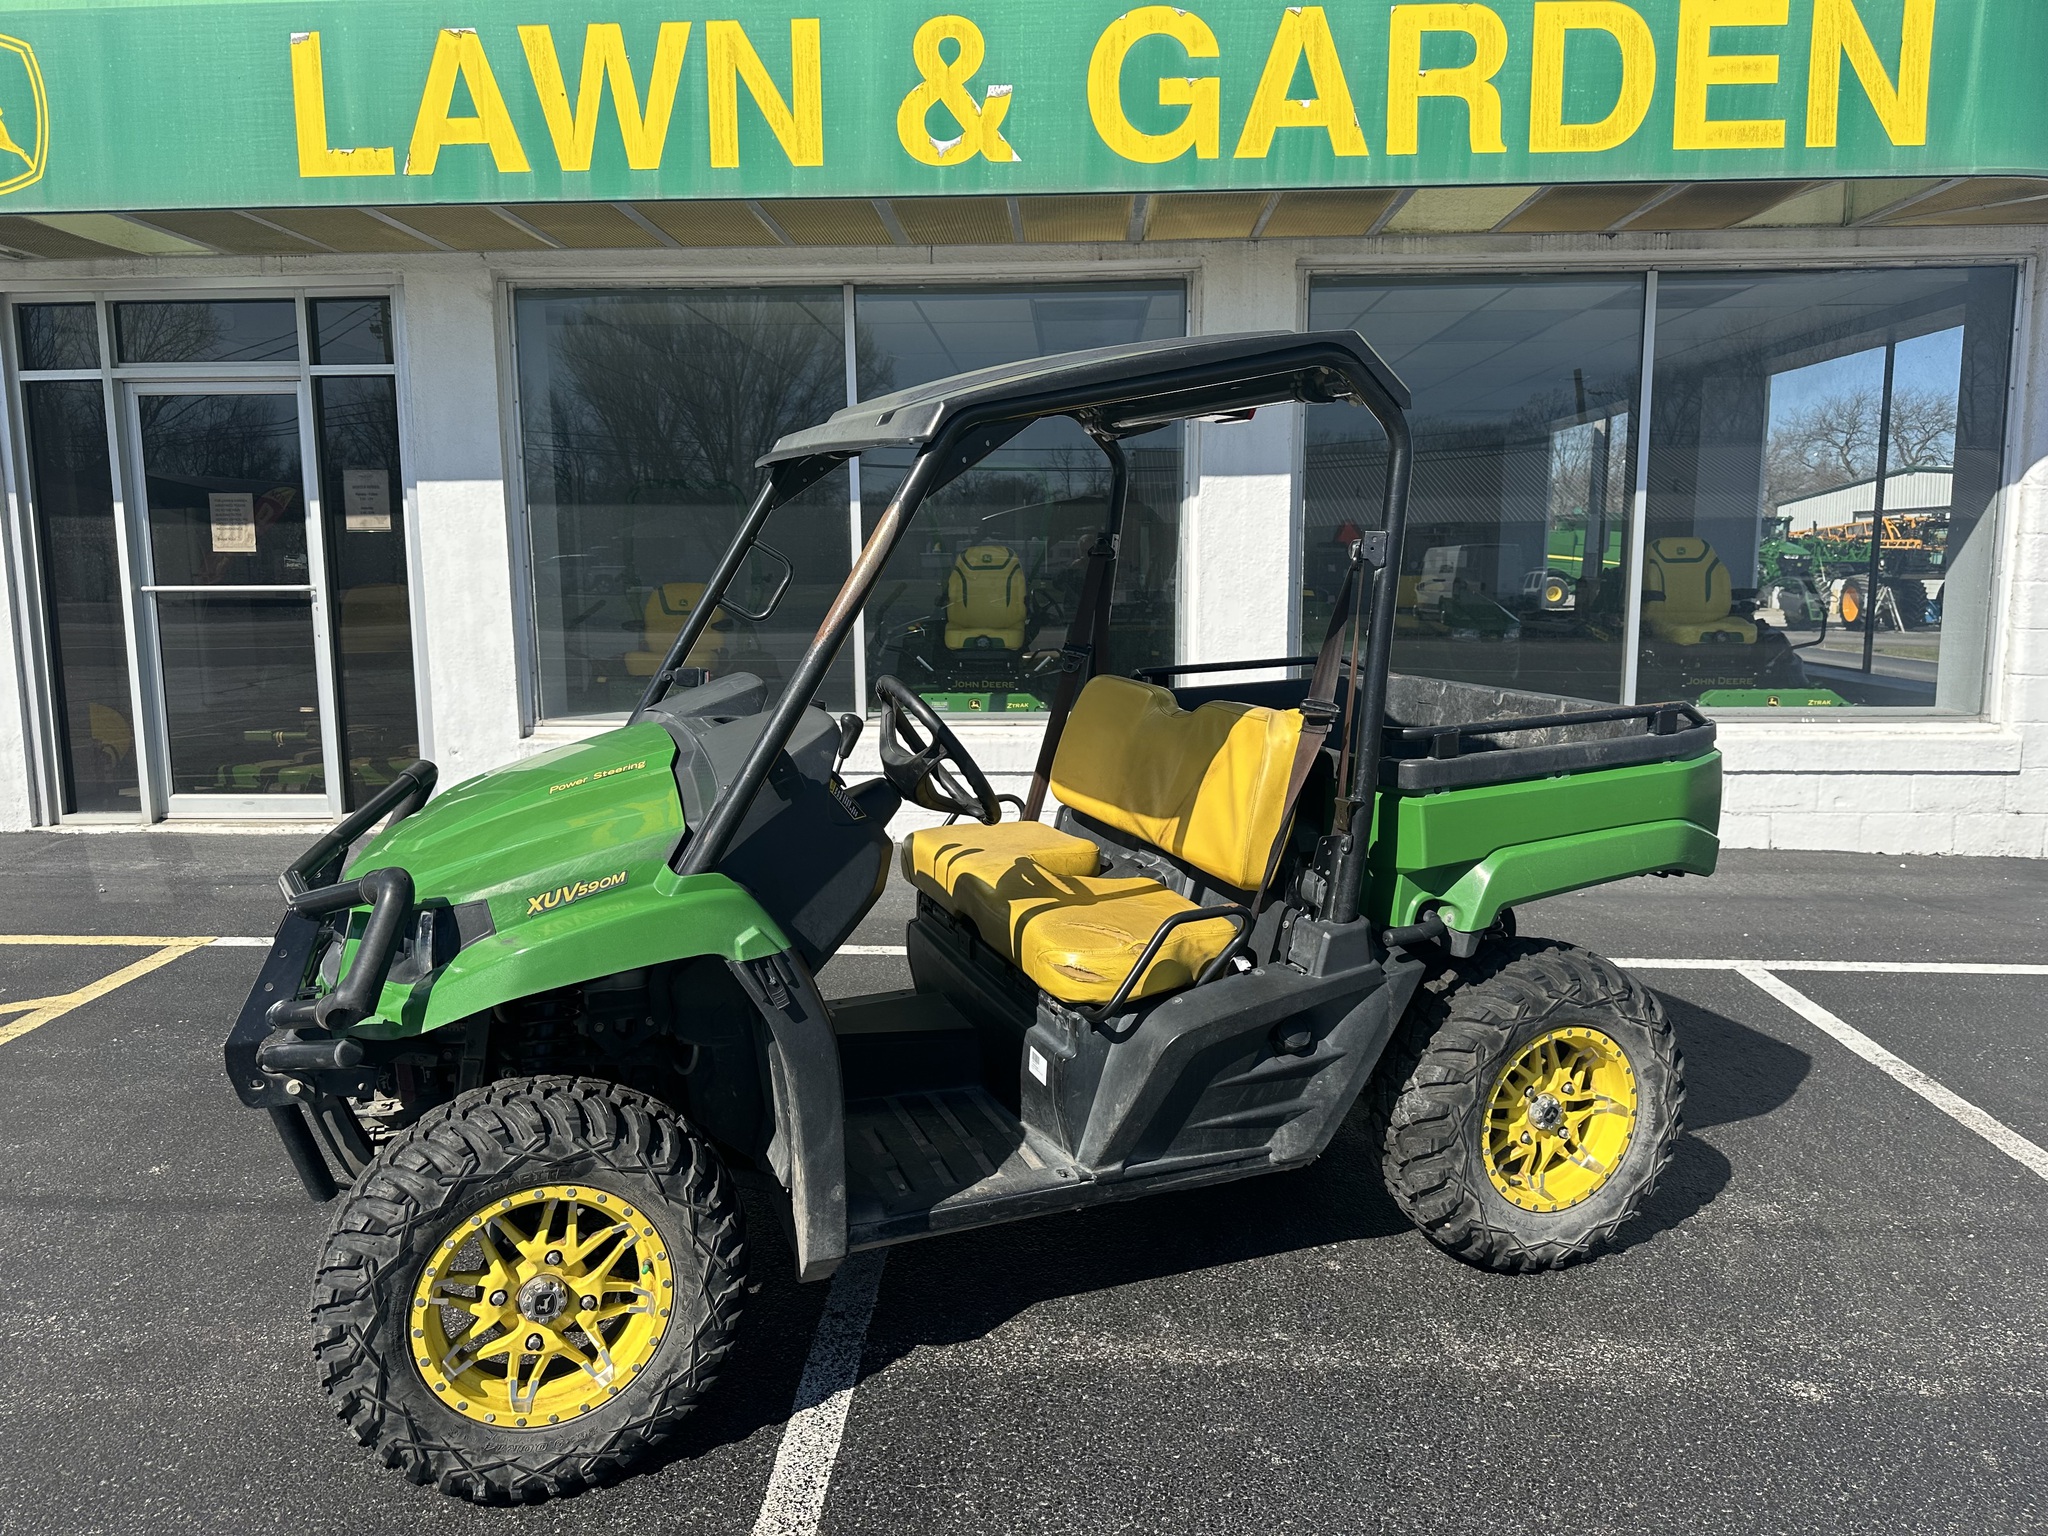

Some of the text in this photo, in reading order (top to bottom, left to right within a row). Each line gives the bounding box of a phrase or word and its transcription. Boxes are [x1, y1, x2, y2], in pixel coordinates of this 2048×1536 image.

[290, 0, 1937, 178] LAWN & GARDEN
[952, 680, 1015, 689] JOHN DEERE
[1686, 676, 1754, 685] JOHN DEERE
[549, 760, 646, 794] Power Steering
[526, 871, 627, 915] XUV590M
[676, 1259, 696, 1336] TUSK
